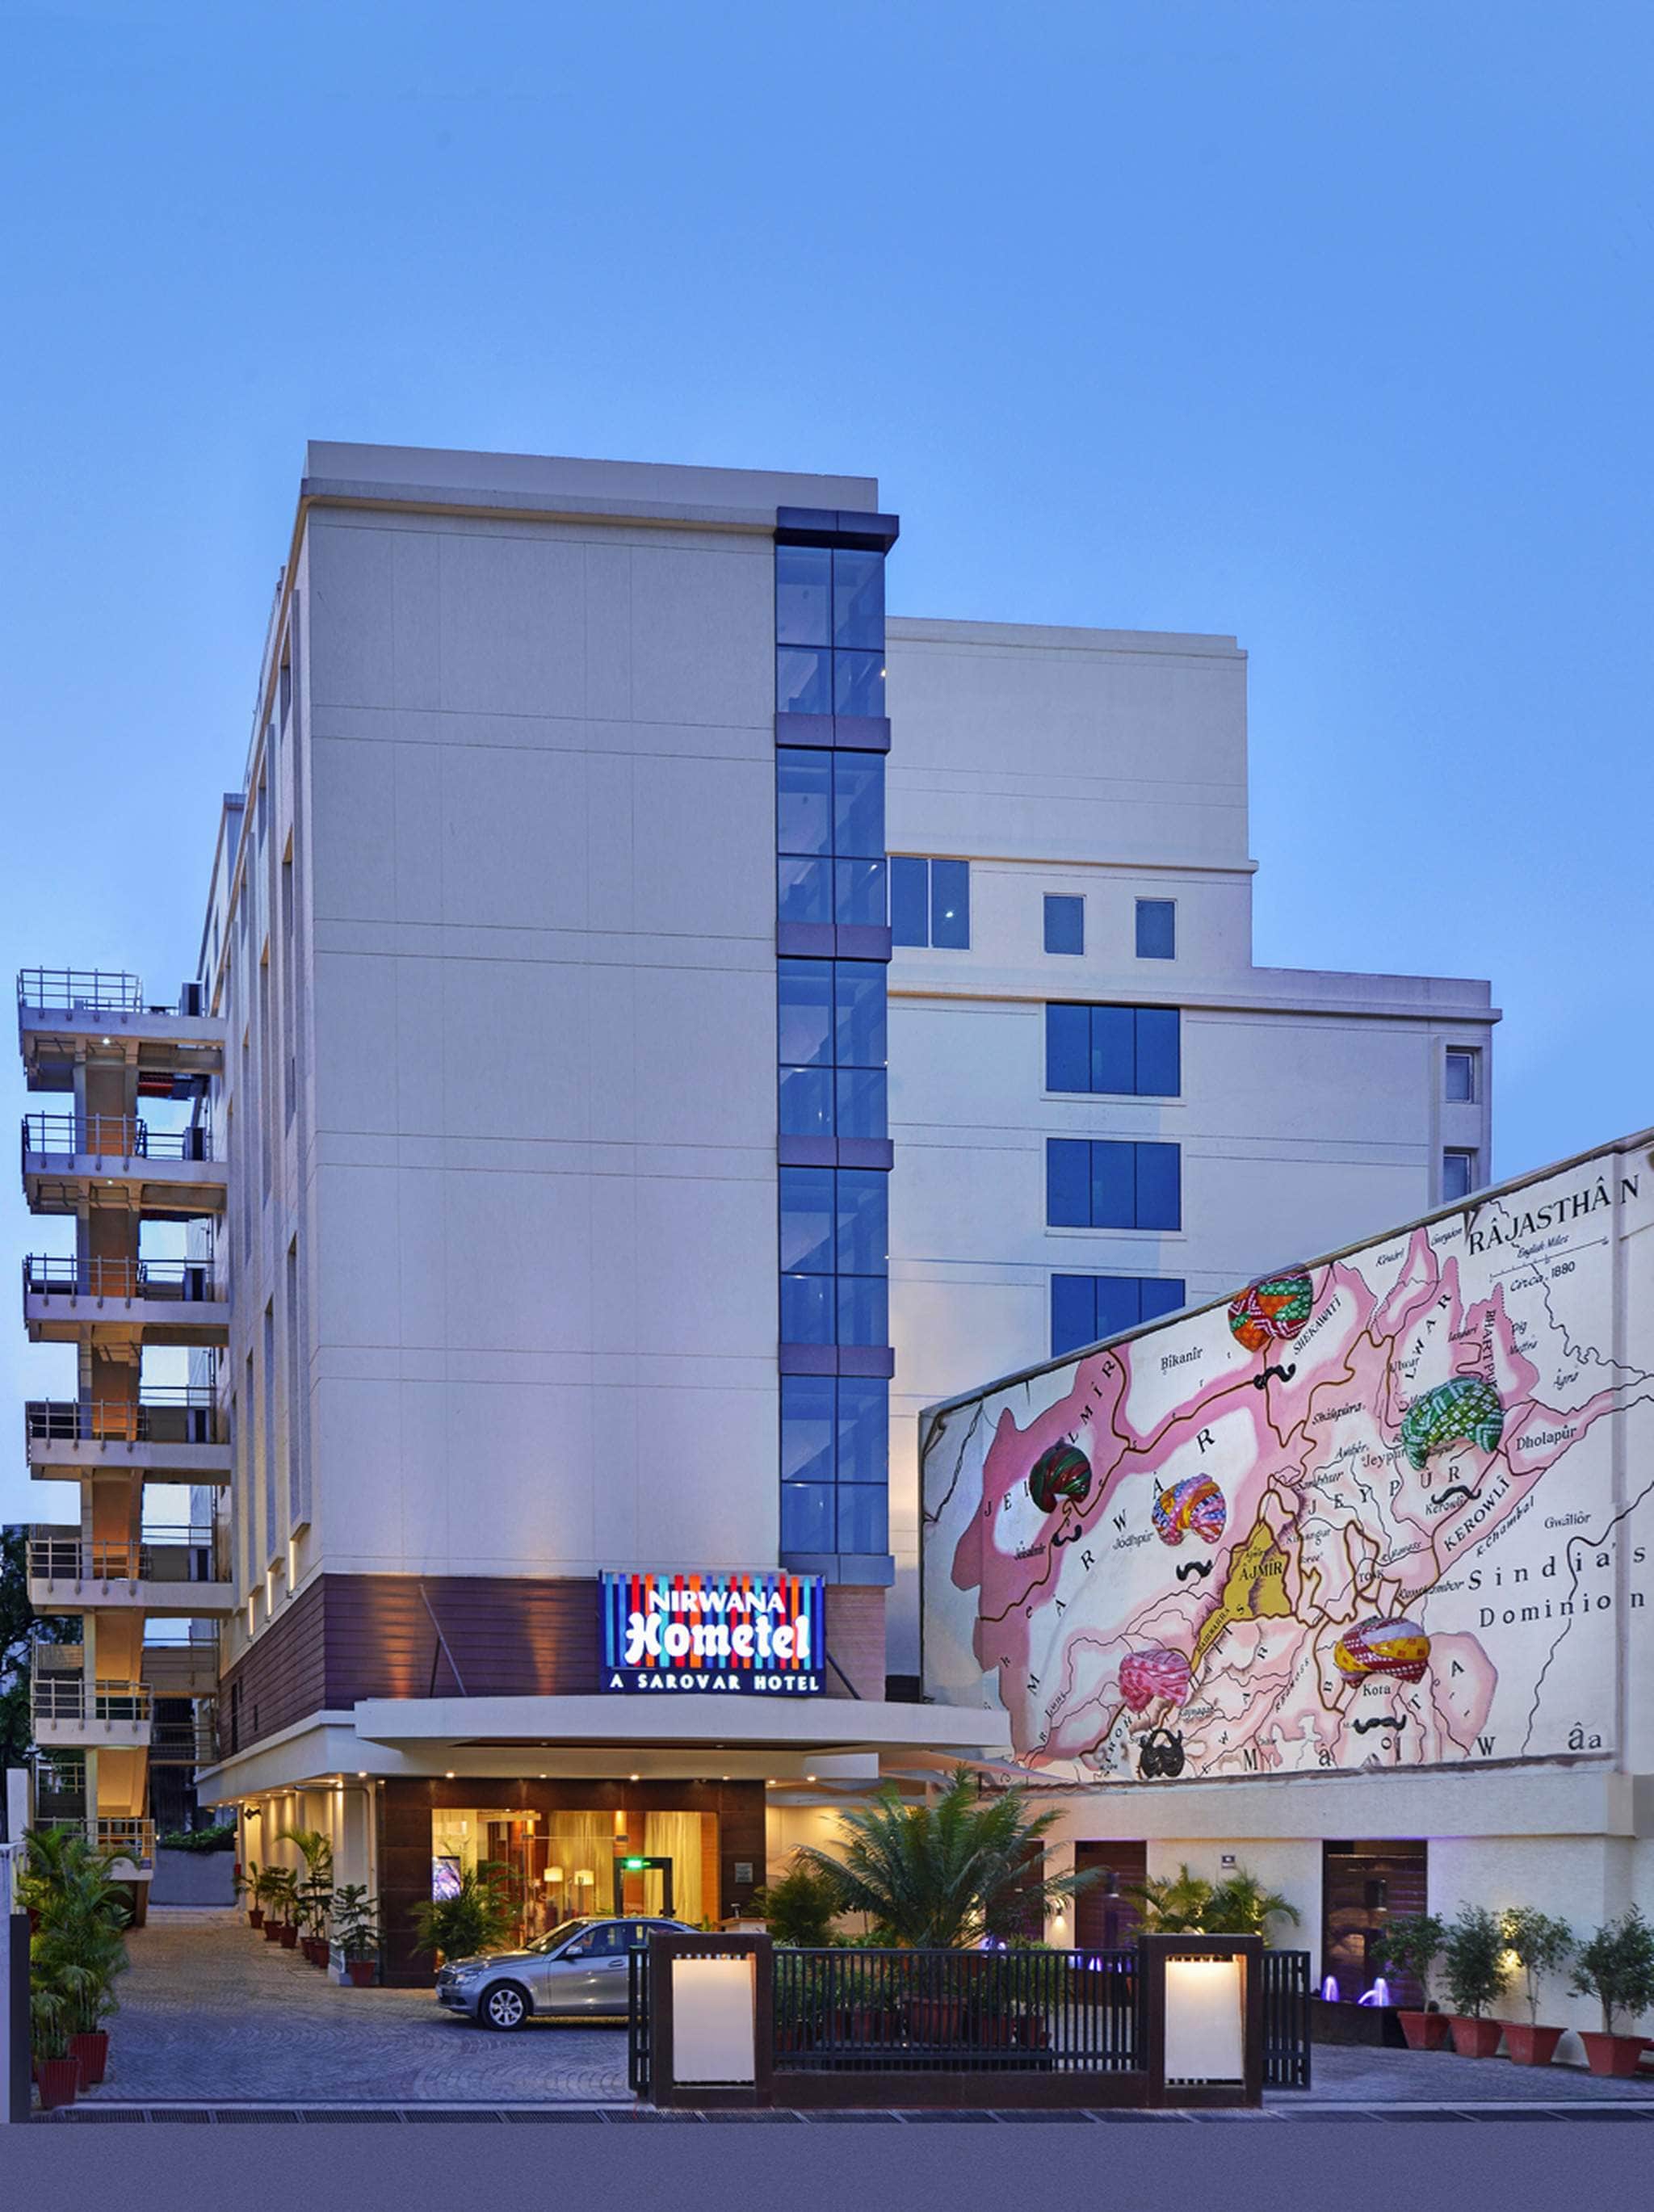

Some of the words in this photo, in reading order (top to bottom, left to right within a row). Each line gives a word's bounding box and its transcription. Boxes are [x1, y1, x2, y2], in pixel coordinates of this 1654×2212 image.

[1469, 1175, 1640, 1256] RÂJASTHÂN
[1551, 1260, 1576, 1278] 1880
[649, 1589, 785, 1614] NIRWANA
[1479, 1592, 1646, 1629] Dominion
[624, 1611, 810, 1664] Hometel
[610, 1673, 624, 1689] A
[637, 1674, 741, 1690] SAROVAR
[754, 1676, 819, 1691] HOTEL
